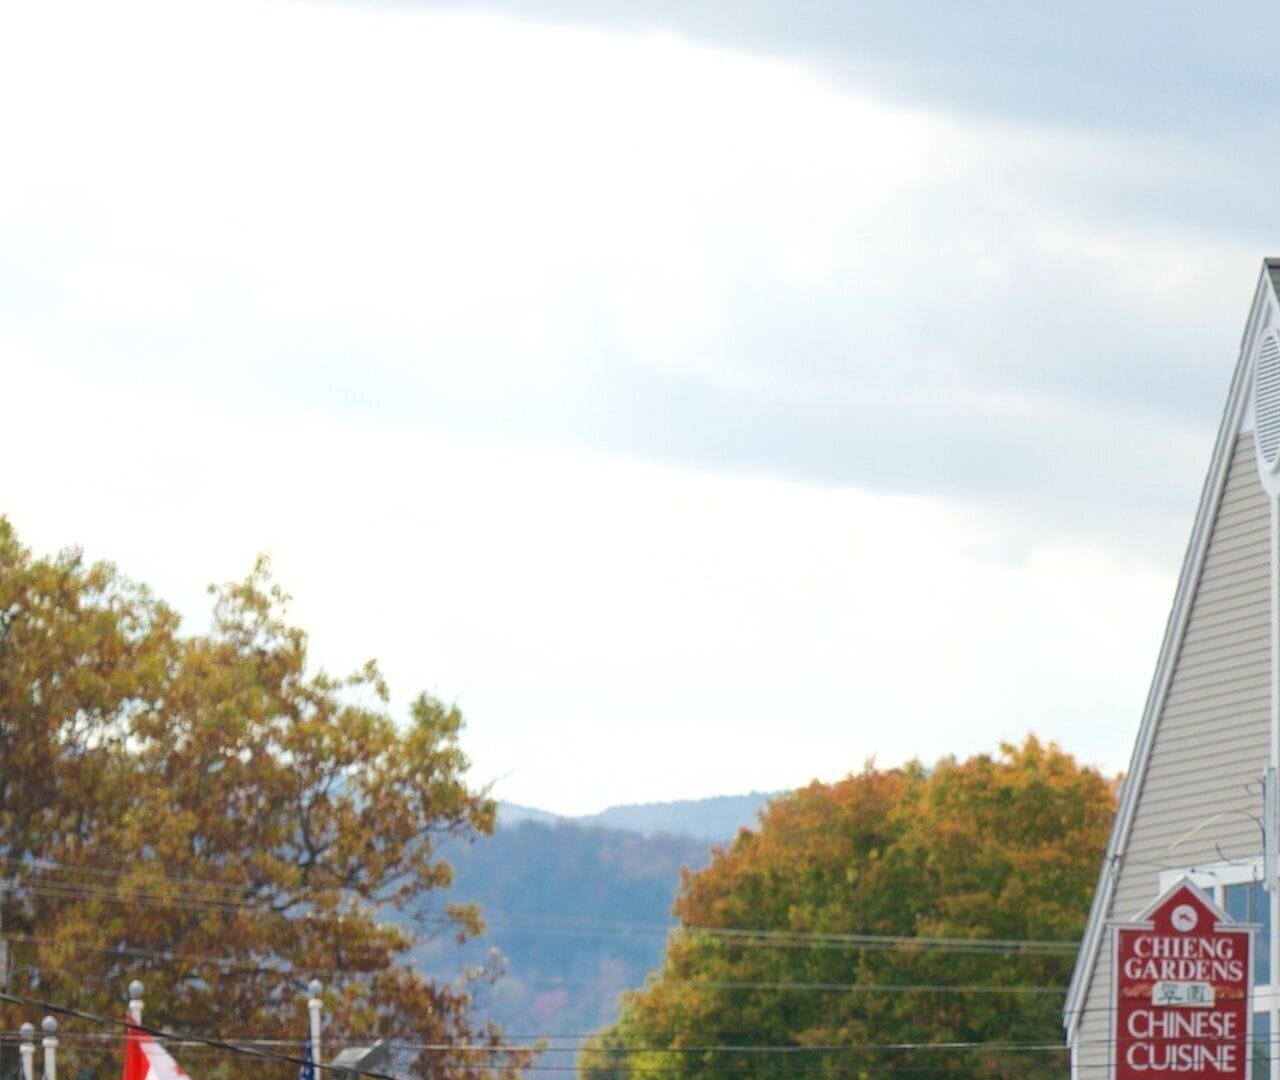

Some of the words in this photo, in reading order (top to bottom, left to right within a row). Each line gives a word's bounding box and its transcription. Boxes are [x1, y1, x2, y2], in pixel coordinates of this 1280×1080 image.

[1134, 936, 1233, 959] CHIENG
[1124, 958, 1243, 981] GARDENS
[1127, 1009, 1237, 1039] CHINESE
[1126, 1042, 1237, 1072] CUISINE
